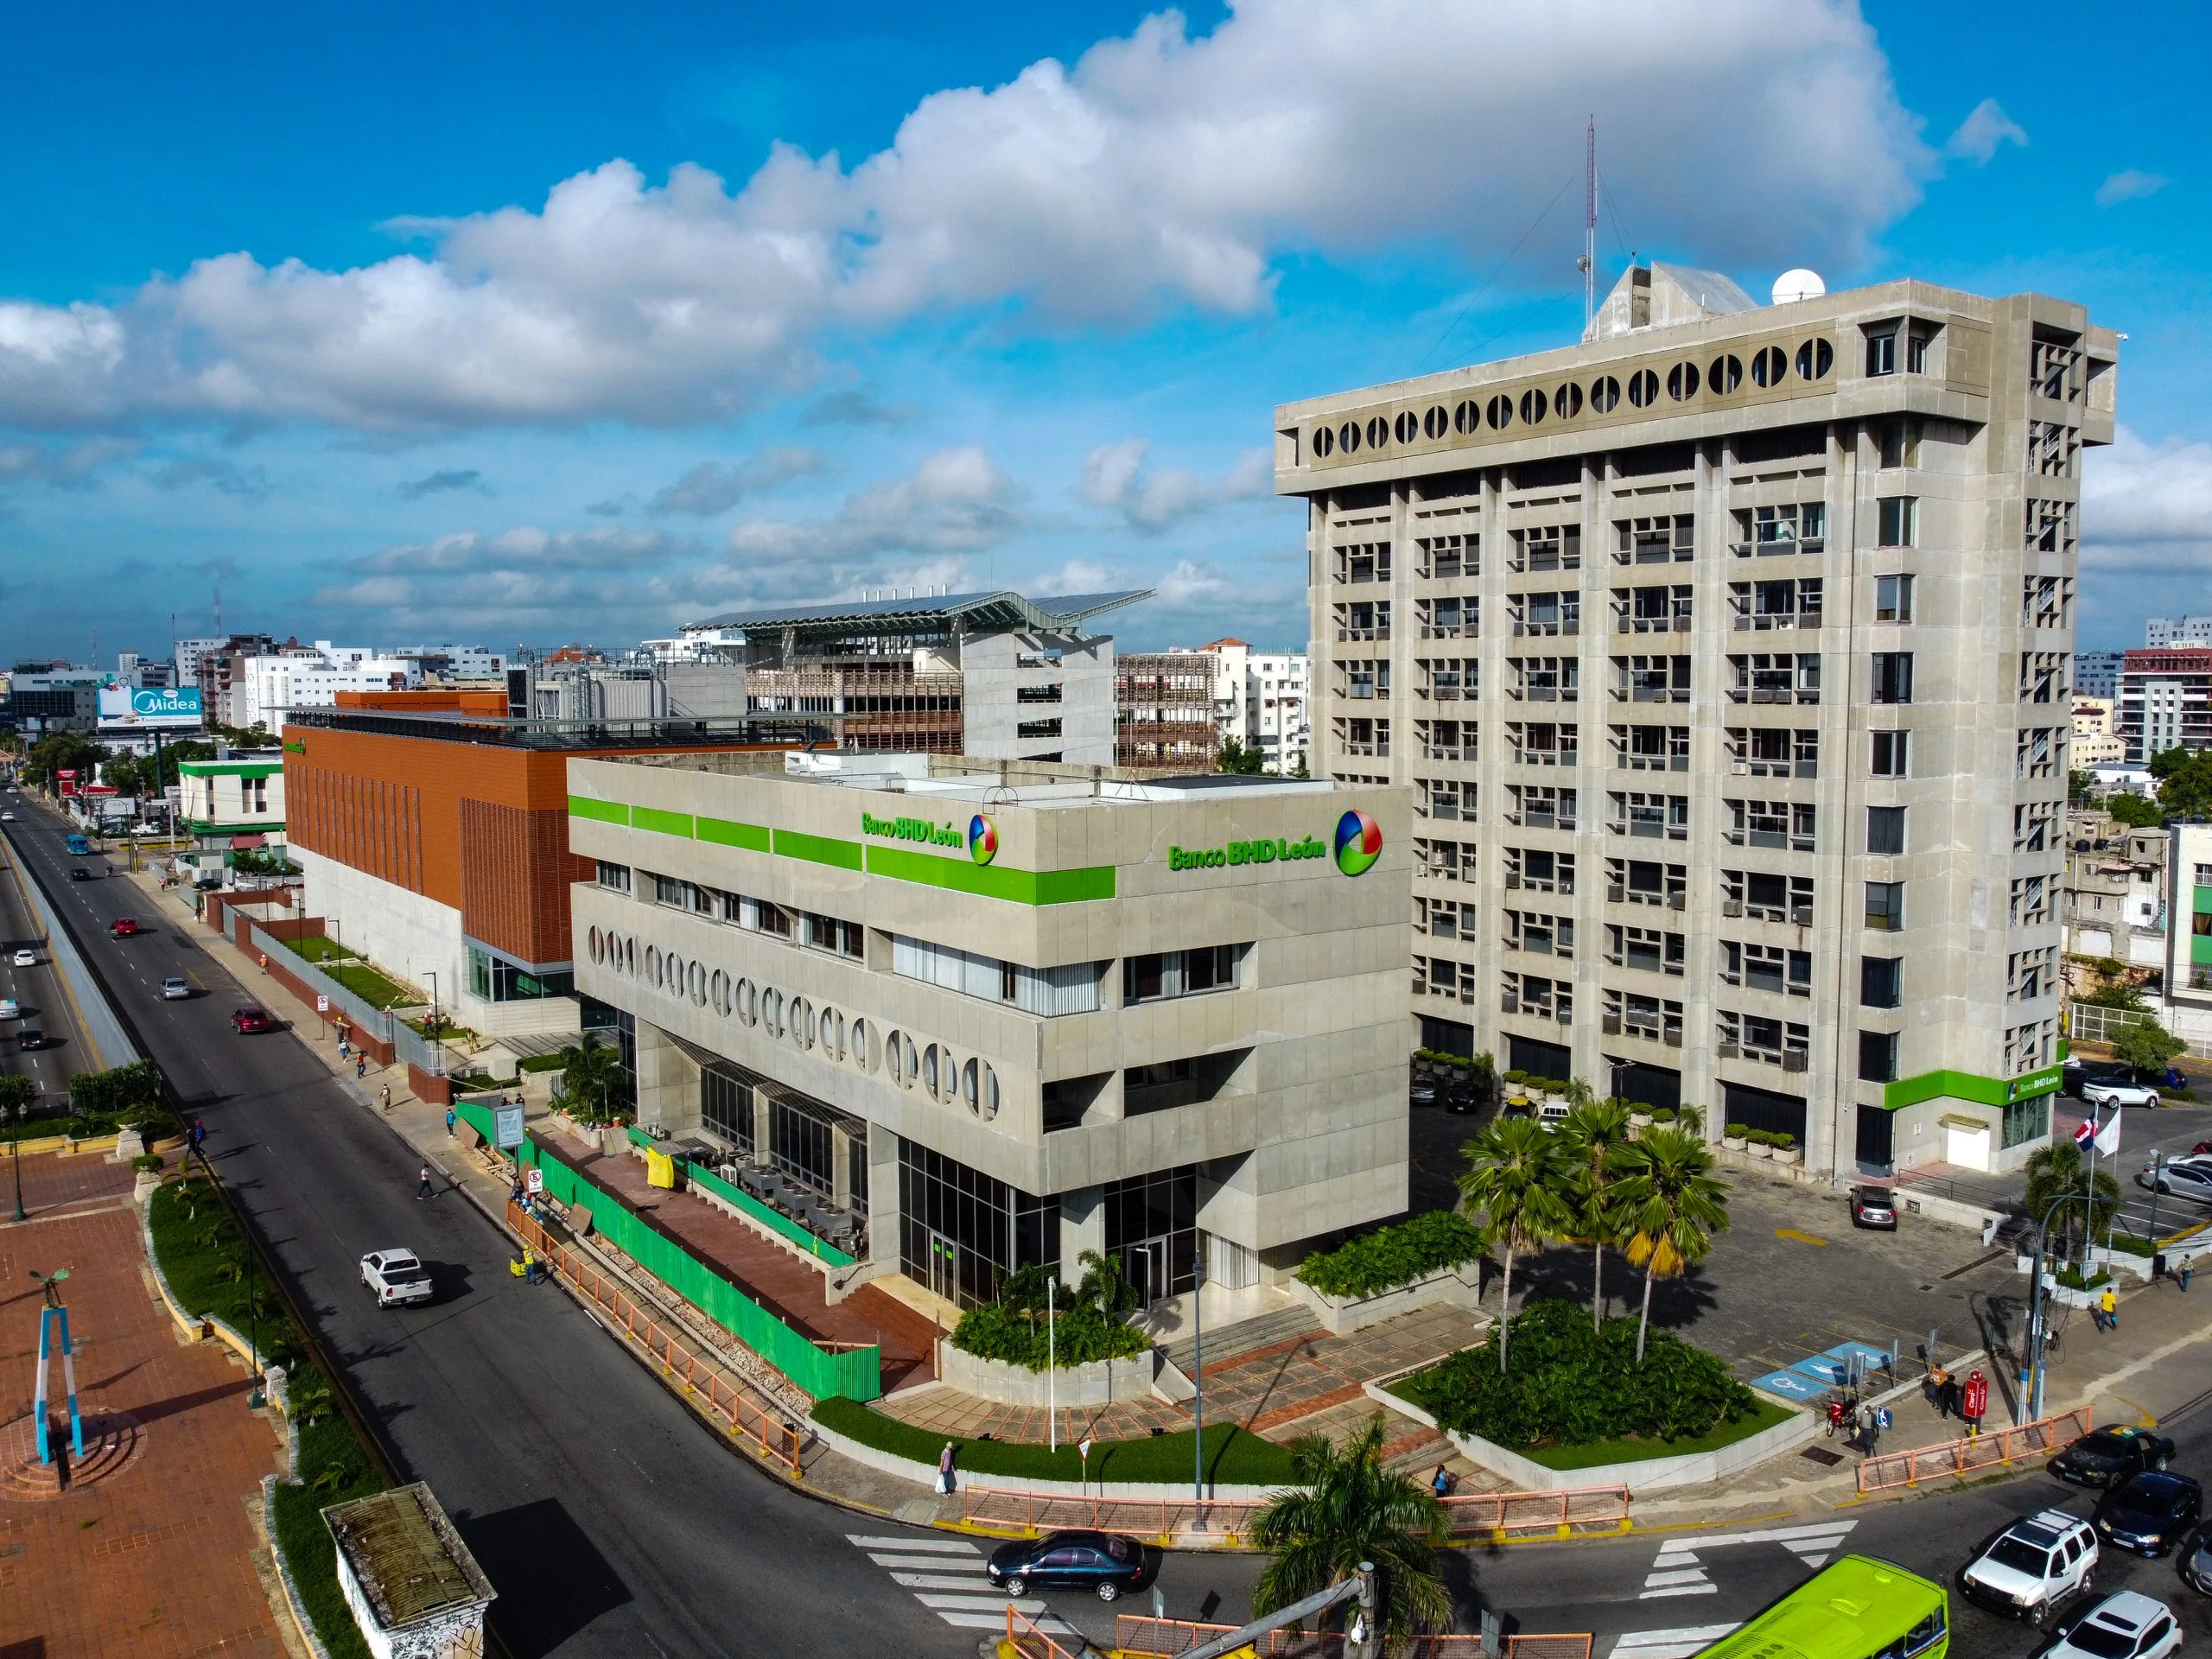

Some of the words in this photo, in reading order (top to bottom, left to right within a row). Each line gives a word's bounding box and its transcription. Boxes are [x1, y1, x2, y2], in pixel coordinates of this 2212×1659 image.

[138, 694, 198, 712] Midea
[861, 811, 896, 838] Banco
[895, 817, 928, 842] BHD
[927, 821, 963, 849] León
[1169, 845, 1226, 871] Banco
[1227, 839, 1277, 865] BHD
[1278, 832, 1326, 861] León
[2020, 1084, 2034, 1093] Banco
[2033, 1077, 2046, 1089] BHD
[2045, 1075, 2058, 1085] León
